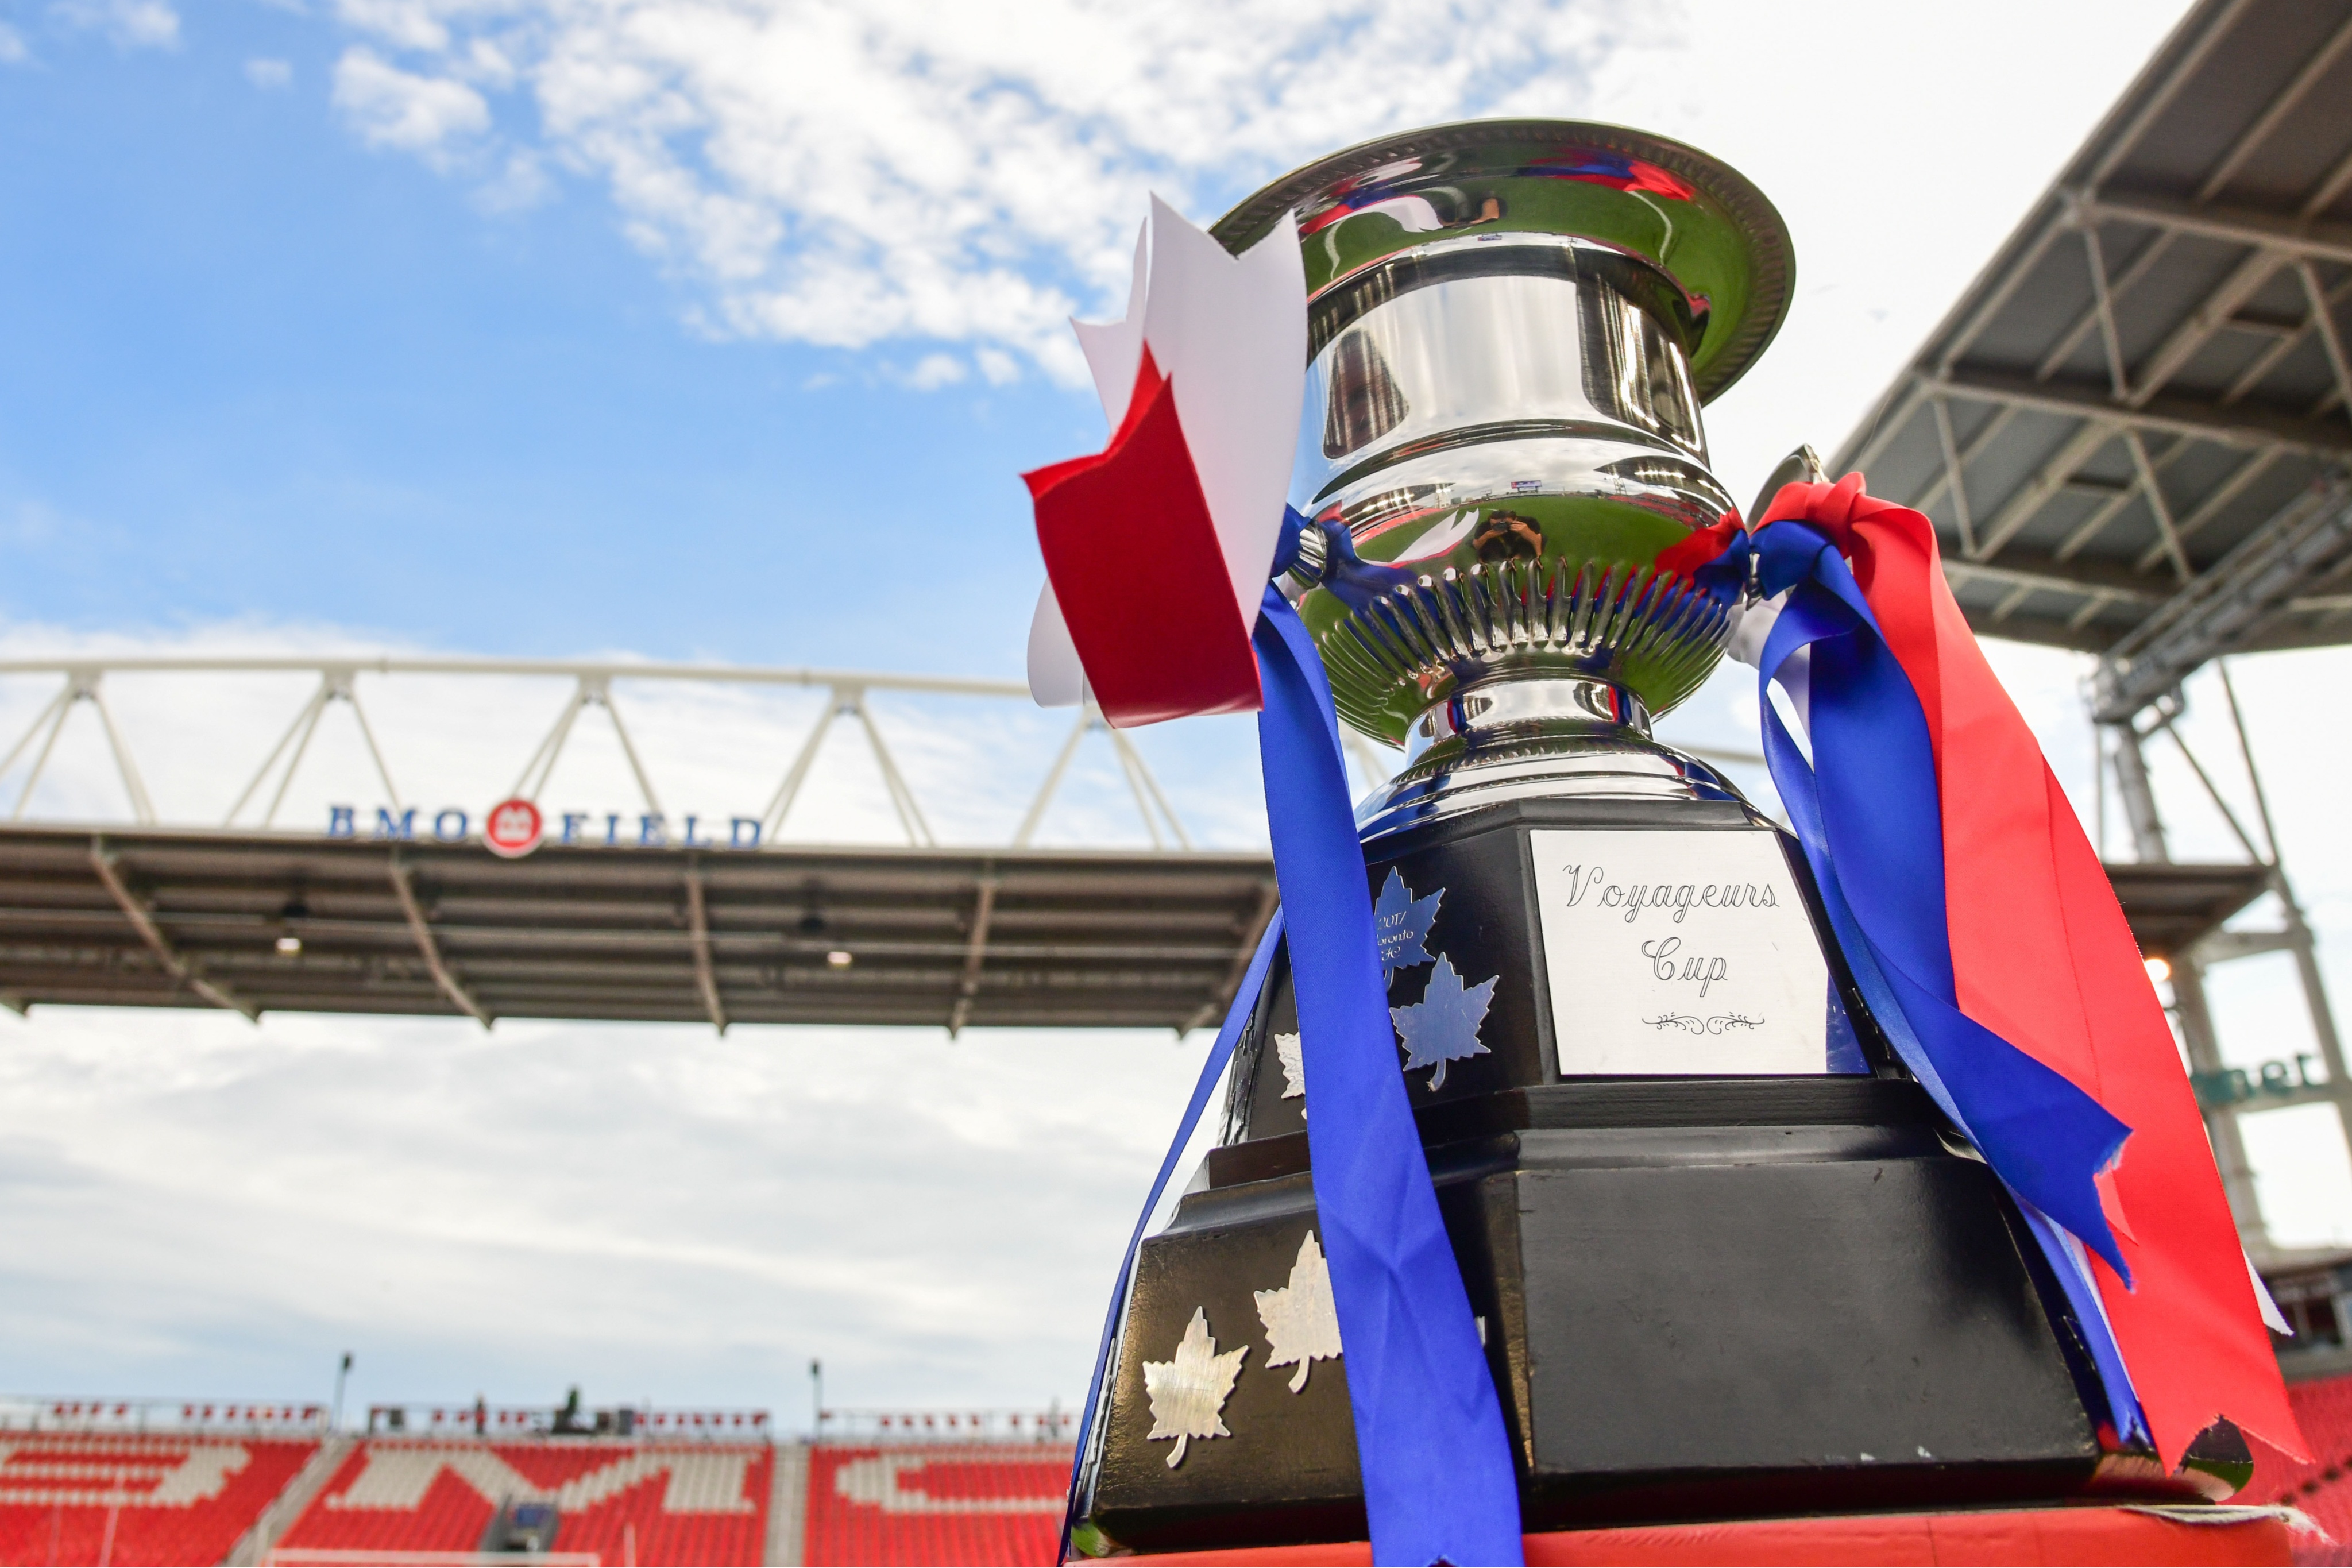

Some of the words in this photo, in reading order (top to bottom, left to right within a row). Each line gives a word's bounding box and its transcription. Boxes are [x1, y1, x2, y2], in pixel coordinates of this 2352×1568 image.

[328, 806, 468, 843] BMO
[561, 813, 761, 848] FIELD
[1562, 864, 1780, 924] Voyageurs
[1376, 929, 1414, 946] oronto
[1377, 910, 1407, 930] 2017
[1641, 936, 1728, 998] Cup
